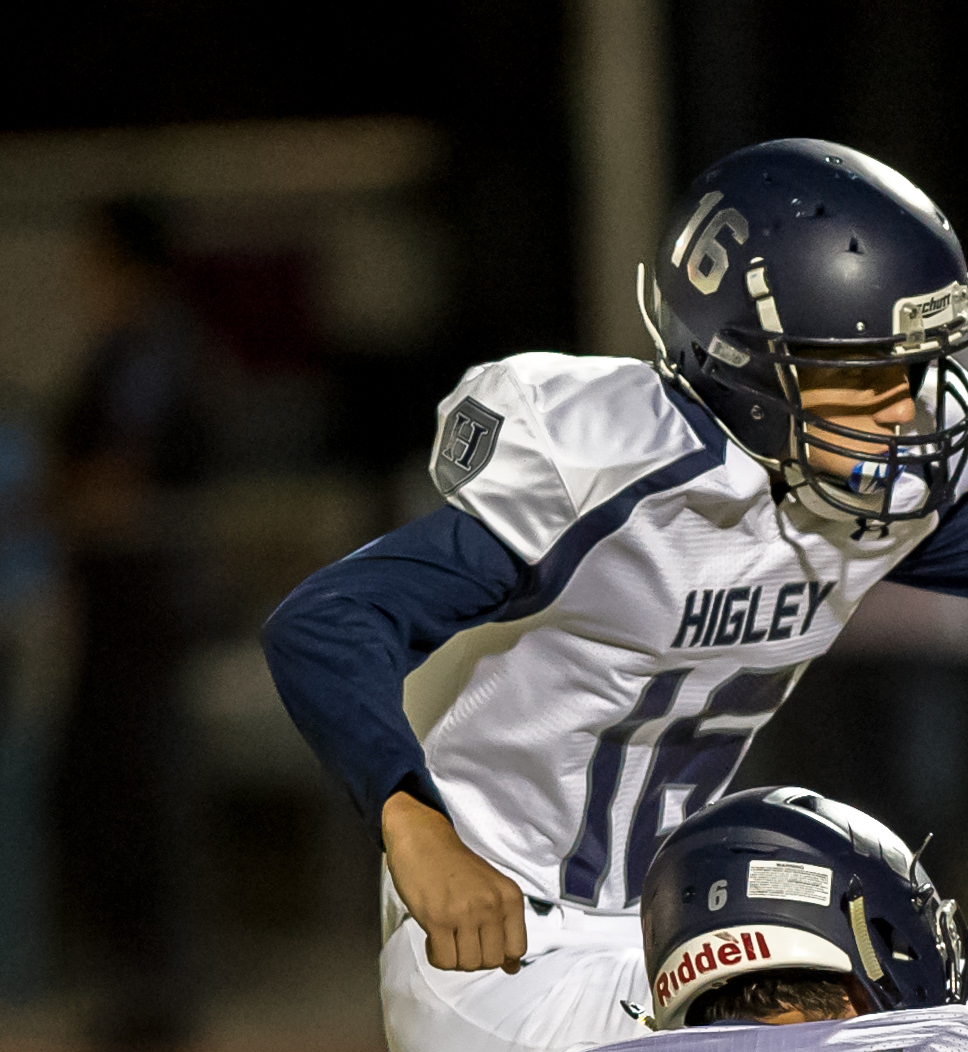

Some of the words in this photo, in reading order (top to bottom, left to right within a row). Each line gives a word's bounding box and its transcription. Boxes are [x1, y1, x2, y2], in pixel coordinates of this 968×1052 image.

[671, 190, 750, 296] 16
[441, 411, 489, 472] H
[670, 580, 839, 649] HIGLEY
[707, 880, 728, 911] 6
[655, 931, 772, 1007] Riddell
